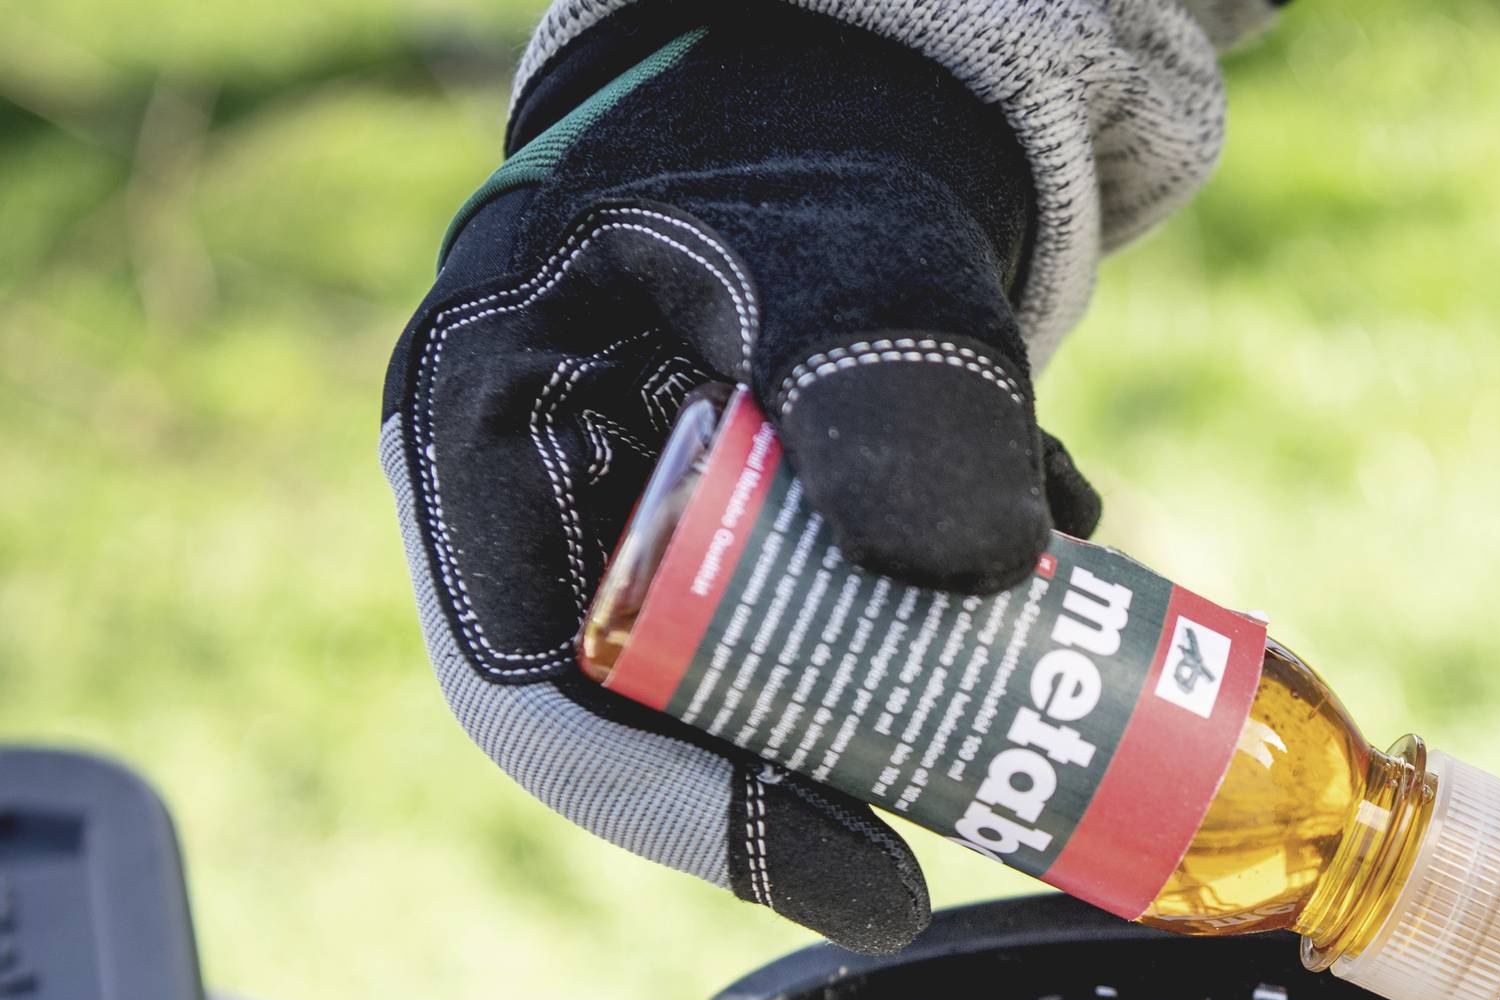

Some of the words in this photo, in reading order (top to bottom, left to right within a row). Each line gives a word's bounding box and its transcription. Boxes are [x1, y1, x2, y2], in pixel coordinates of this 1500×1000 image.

[721, 469, 758, 528] Metabo
[692, 529, 733, 596] Qualität
[822, 575, 859, 643] corrente
[849, 618, 873, 653] para
[811, 644, 831, 666] de
[960, 646, 988, 690] chain
[792, 666, 819, 702] serra
[822, 653, 857, 707] cadenas
[852, 689, 872, 715] per
[886, 687, 910, 713] 100
[955, 566, 1133, 863] metab
[814, 707, 832, 724] de
[874, 712, 893, 735] ml
[921, 692, 971, 768] lubrication
[890, 743, 913, 765] bio
[958, 735, 982, 761] 100
[911, 768, 928, 786] oil
[947, 760, 966, 781] ml
